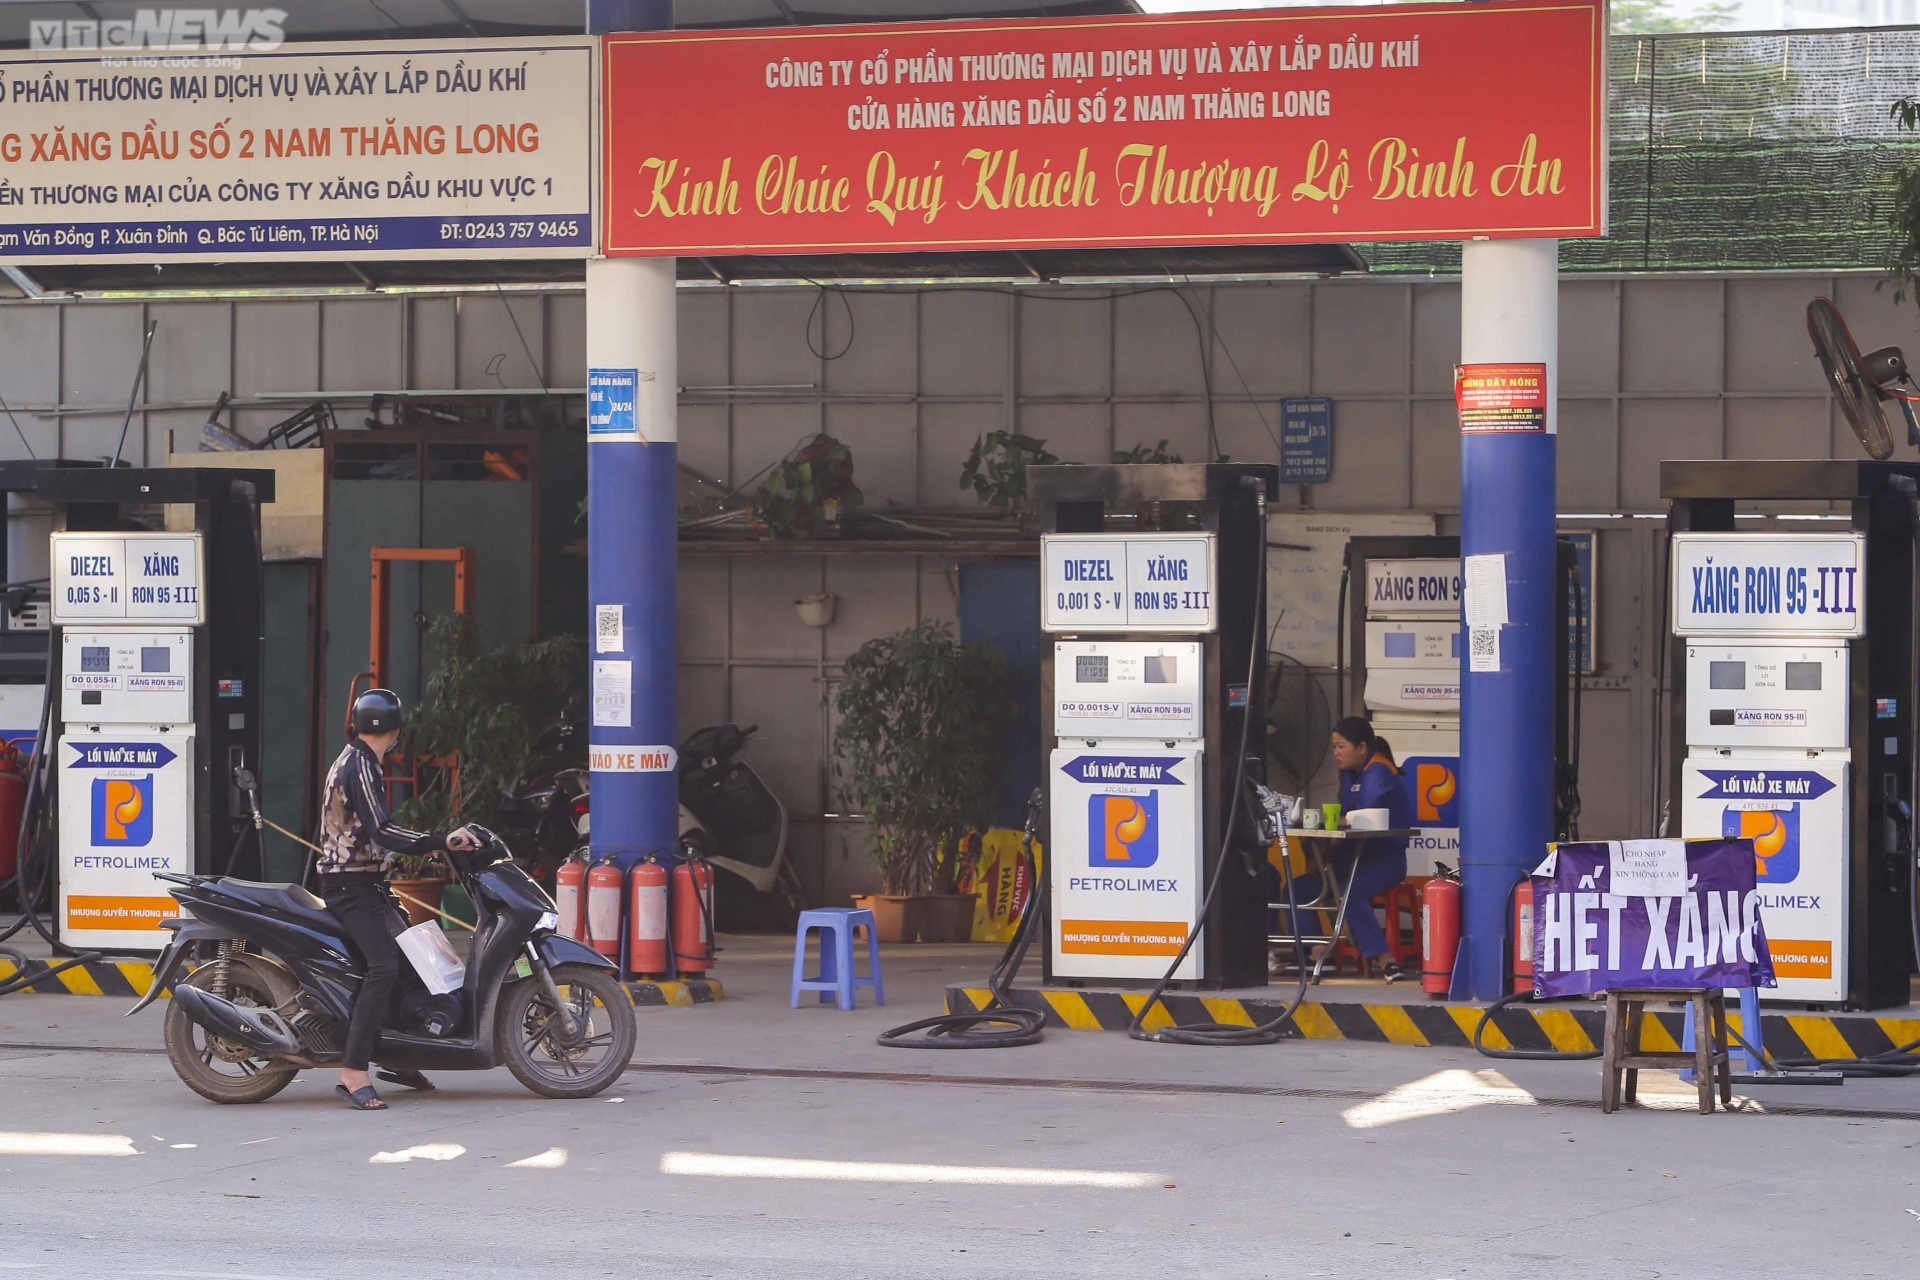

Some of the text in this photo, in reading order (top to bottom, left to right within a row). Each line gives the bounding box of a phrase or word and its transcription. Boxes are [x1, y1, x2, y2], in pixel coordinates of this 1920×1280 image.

[765, 33, 1420, 88] CÔNG TY CỔ PHẦN THƯƠNG MẠI DỊCH VỤ VÀ XÂY LẮP DẦU KHÍ
[13, 71, 69, 103] PHẦN
[75, 76, 163, 101] THƯƠNG
[170, 76, 207, 103] MẠI
[214, 74, 262, 103] DỊCH
[269, 73, 299, 102] VỤ
[304, 66, 330, 96] VÀ
[335, 66, 378, 95] XÂY
[385, 60, 429, 94] LẮP
[436, 60, 482, 93] DẦU
[489, 61, 528, 91] KHÍ
[847, 86, 1330, 131] CỬA HÀNG XĂNG DẦU SỐ 2 NAM THĂNG LONG
[30, 126, 112, 162] XĂNG
[121, 119, 179, 160] DẦU
[189, 117, 231, 159] SỐ
[239, 129, 255, 159] 2
[265, 127, 331, 158] NAM
[341, 117, 445, 156] THĂNG
[456, 122, 539, 154] LONG
[30, 184, 118, 206] THƯƠNG
[125, 185, 163, 208] MẠI
[169, 177, 212, 203] CỦA
[218, 179, 279, 202] CÔNG
[286, 182, 313, 201] TY
[319, 176, 380, 200] XĂNG
[387, 171, 430, 199] DẦU
[437, 179, 483, 198] KHU
[490, 176, 536, 202] VỰC
[544, 178, 553, 195] 1
[633, 133, 1565, 227] Kính Chúc Quý Khách Thượng Lộ Bình An
[23, 228, 50, 246] Văn
[54, 225, 94, 249] Đồng
[101, 231, 110, 245] P.
[115, 228, 151, 244] Xuân
[198, 229, 215, 245] Q.
[249, 225, 265, 242] Từ
[269, 224, 306, 245] Liêm,
[310, 226, 327, 242] TP.
[330, 224, 350, 241] Hà
[354, 224, 379, 244] Nội
[440, 220, 579, 239] ĐT: 0243 757 9465
[1487, 377, 1506, 387] DÂY
[1509, 377, 1538, 387] NÓNG
[613, 402, 632, 412] 24/24
[70, 556, 114, 577] DIEZEL
[143, 552, 179, 577] XĂNG
[1064, 559, 1114, 581] DIEZEL
[1147, 555, 1188, 581] XĂNG
[1692, 556, 1739, 614] XĂNG
[1745, 566, 1780, 614] RON
[1786, 567, 1807, 614] 95
[67, 587, 118, 605] 0,05 S II
[133, 587, 154, 603] RON
[158, 587, 170, 603] 95
[1058, 592, 1121, 612] 0,001 S V
[1135, 592, 1159, 609] RON
[1164, 592, 1178, 609] 95
[1689, 649, 1695, 658] 2
[1834, 650, 1839, 658] 1
[1062, 703, 1119, 712] DO 0,001S-V
[1130, 704, 1152, 714] XĂNG
[1737, 711, 1762, 720] XĂNG
[616, 753, 636, 769] XE
[640, 750, 669, 769] MÁY
[1083, 761, 1162, 779] LỐI VÀO XE MÁY
[1722, 775, 1811, 794] LỐI VÀO XE MÁY
[74, 856, 170, 869] PETROLIMEX
[1015, 866, 1024, 888] KHU
[1631, 870, 1659, 878] THÔNG
[1070, 878, 1177, 892] PETROLIMEX
[1756, 895, 1821, 909] OLIMEX
[1544, 865, 1628, 972] HẾT
[1064, 933, 1100, 944] NHƯỢNG
[1132, 935, 1167, 944] THƯƠNG
[1169, 936, 1185, 946] MẠI
